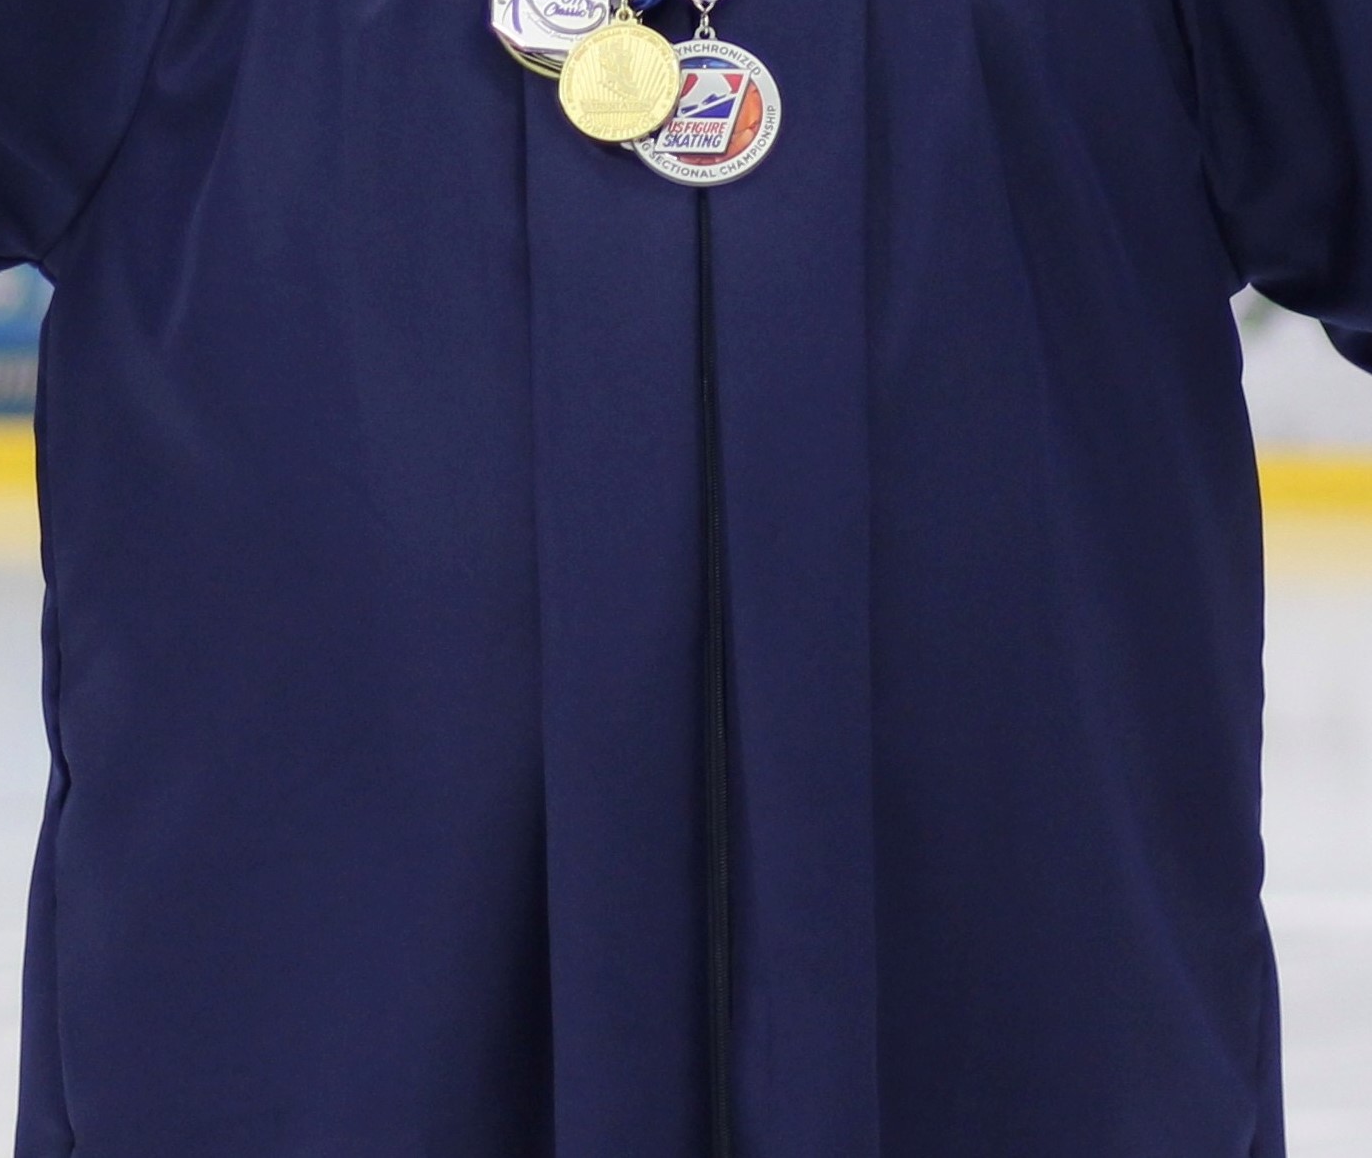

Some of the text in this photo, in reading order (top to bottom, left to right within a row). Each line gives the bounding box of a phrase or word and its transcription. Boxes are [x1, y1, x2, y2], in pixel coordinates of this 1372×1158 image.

[676, 43, 761, 76] YNCHRONIZED
[649, 105, 777, 178] SECTIONAL CHAMPIONSHIP
[663, 134, 723, 148] SKATING
